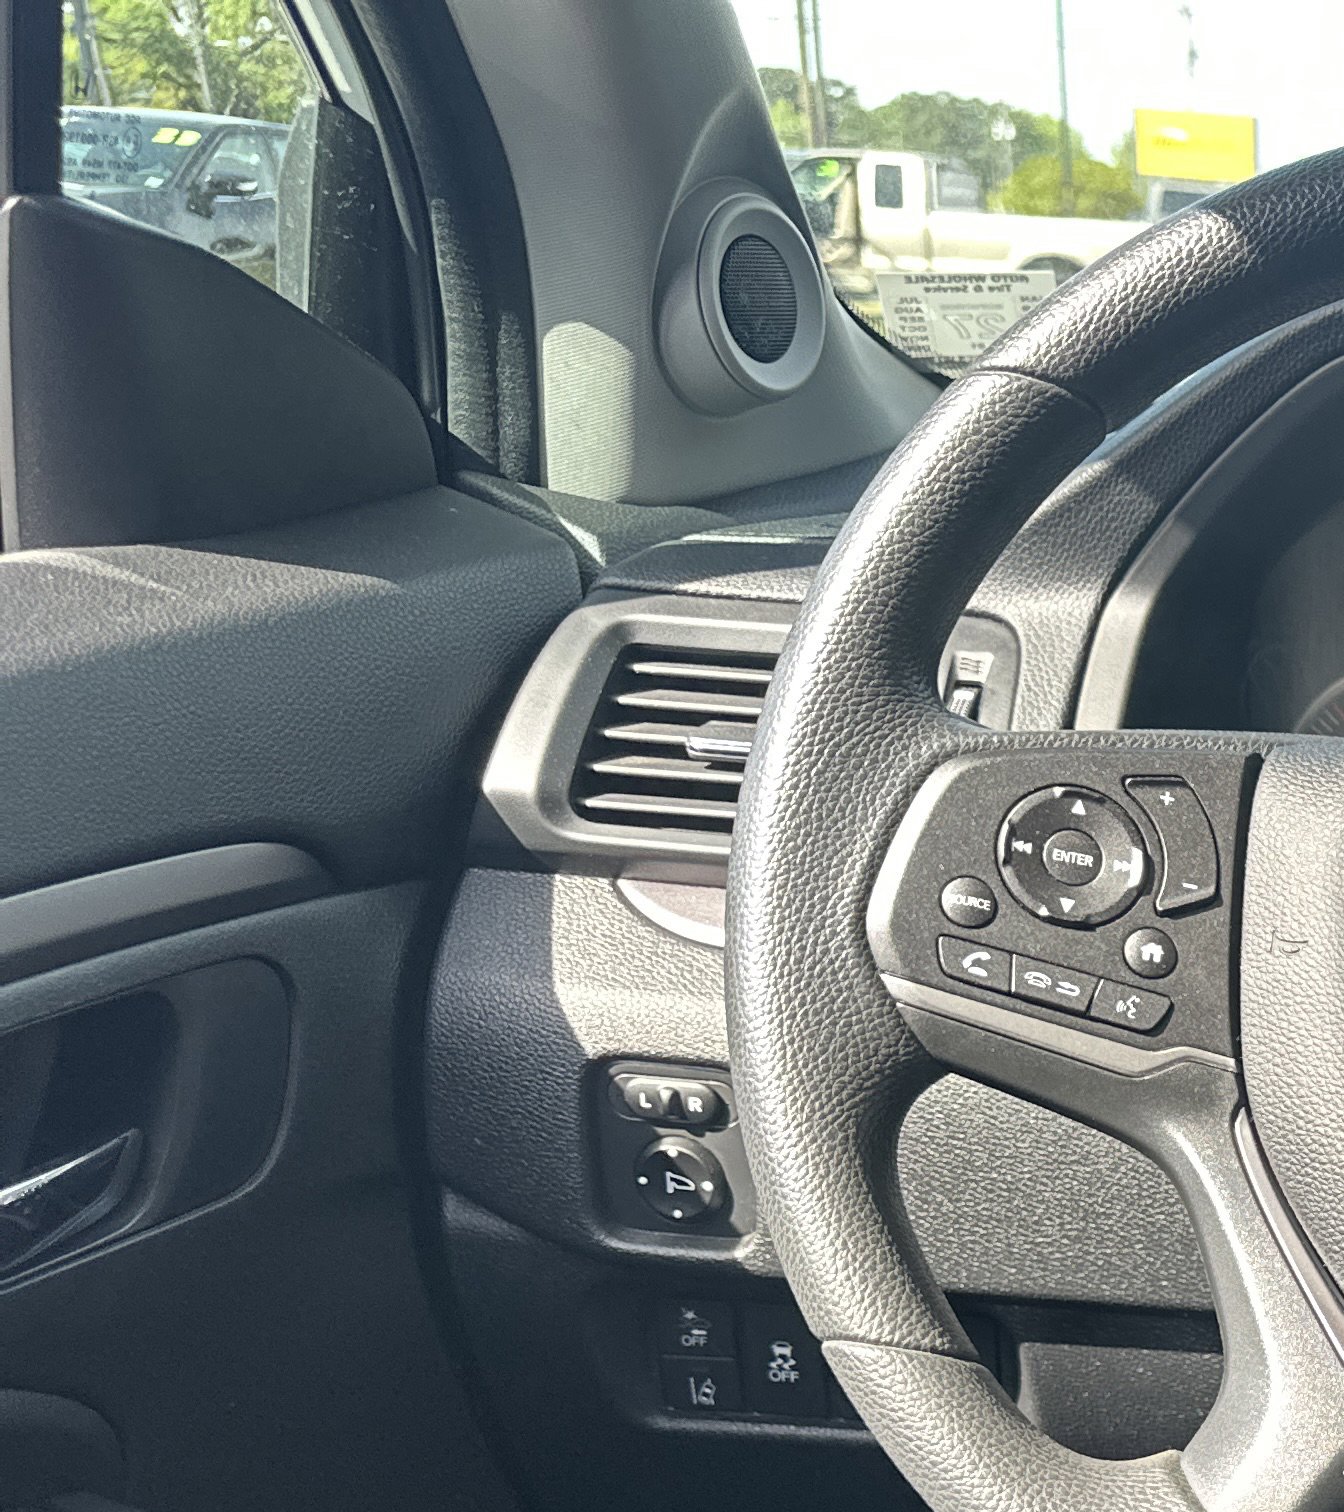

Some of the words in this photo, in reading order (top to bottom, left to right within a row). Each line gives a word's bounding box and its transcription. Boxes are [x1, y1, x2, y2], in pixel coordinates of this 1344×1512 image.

[1052, 847, 1094, 868] ENTER
[639, 1091, 652, 1108] L
[687, 1096, 703, 1113] R
[680, 1334, 708, 1347] OFF
[768, 1369, 799, 1383] OFF
